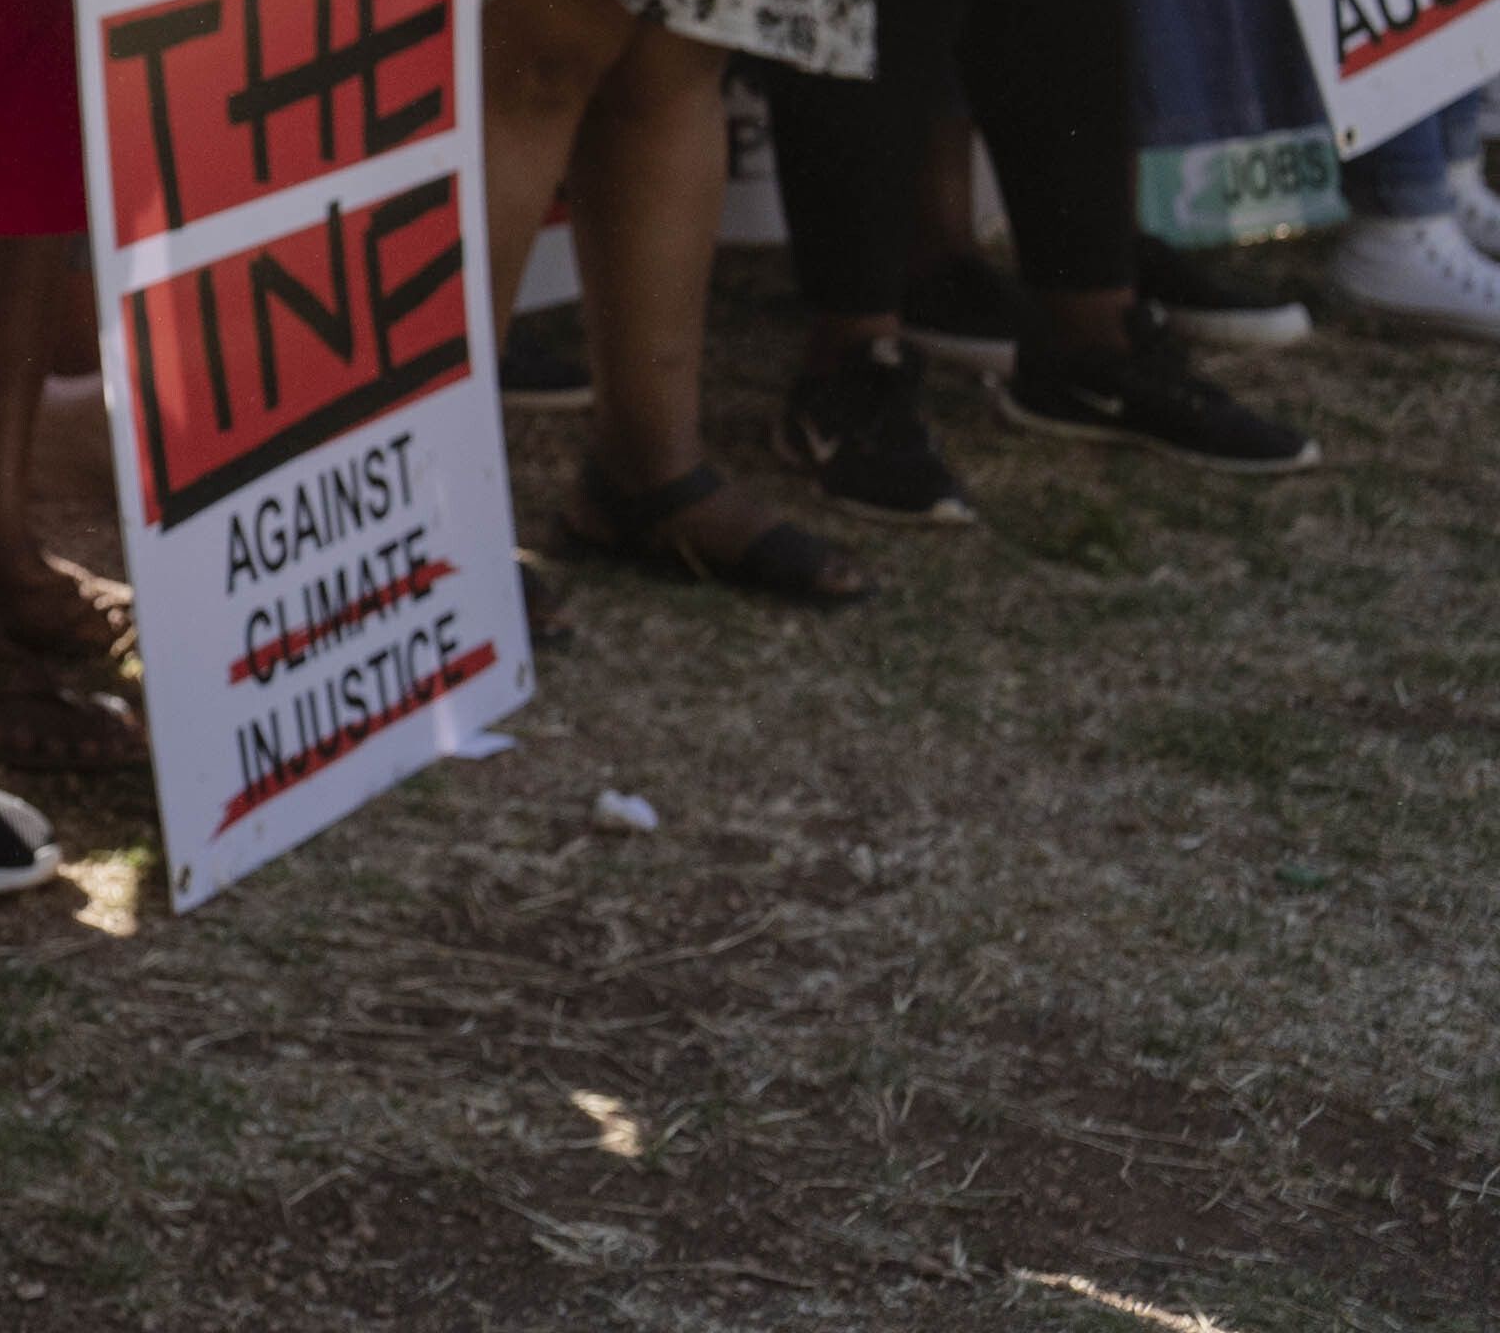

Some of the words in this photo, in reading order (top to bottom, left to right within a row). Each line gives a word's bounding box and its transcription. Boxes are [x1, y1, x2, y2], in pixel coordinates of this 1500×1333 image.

[134, 173, 468, 534] LINE
[227, 431, 413, 595] AGAINST
[246, 526, 432, 689] CLIMATE
[237, 611, 467, 797] INJUSTICE
